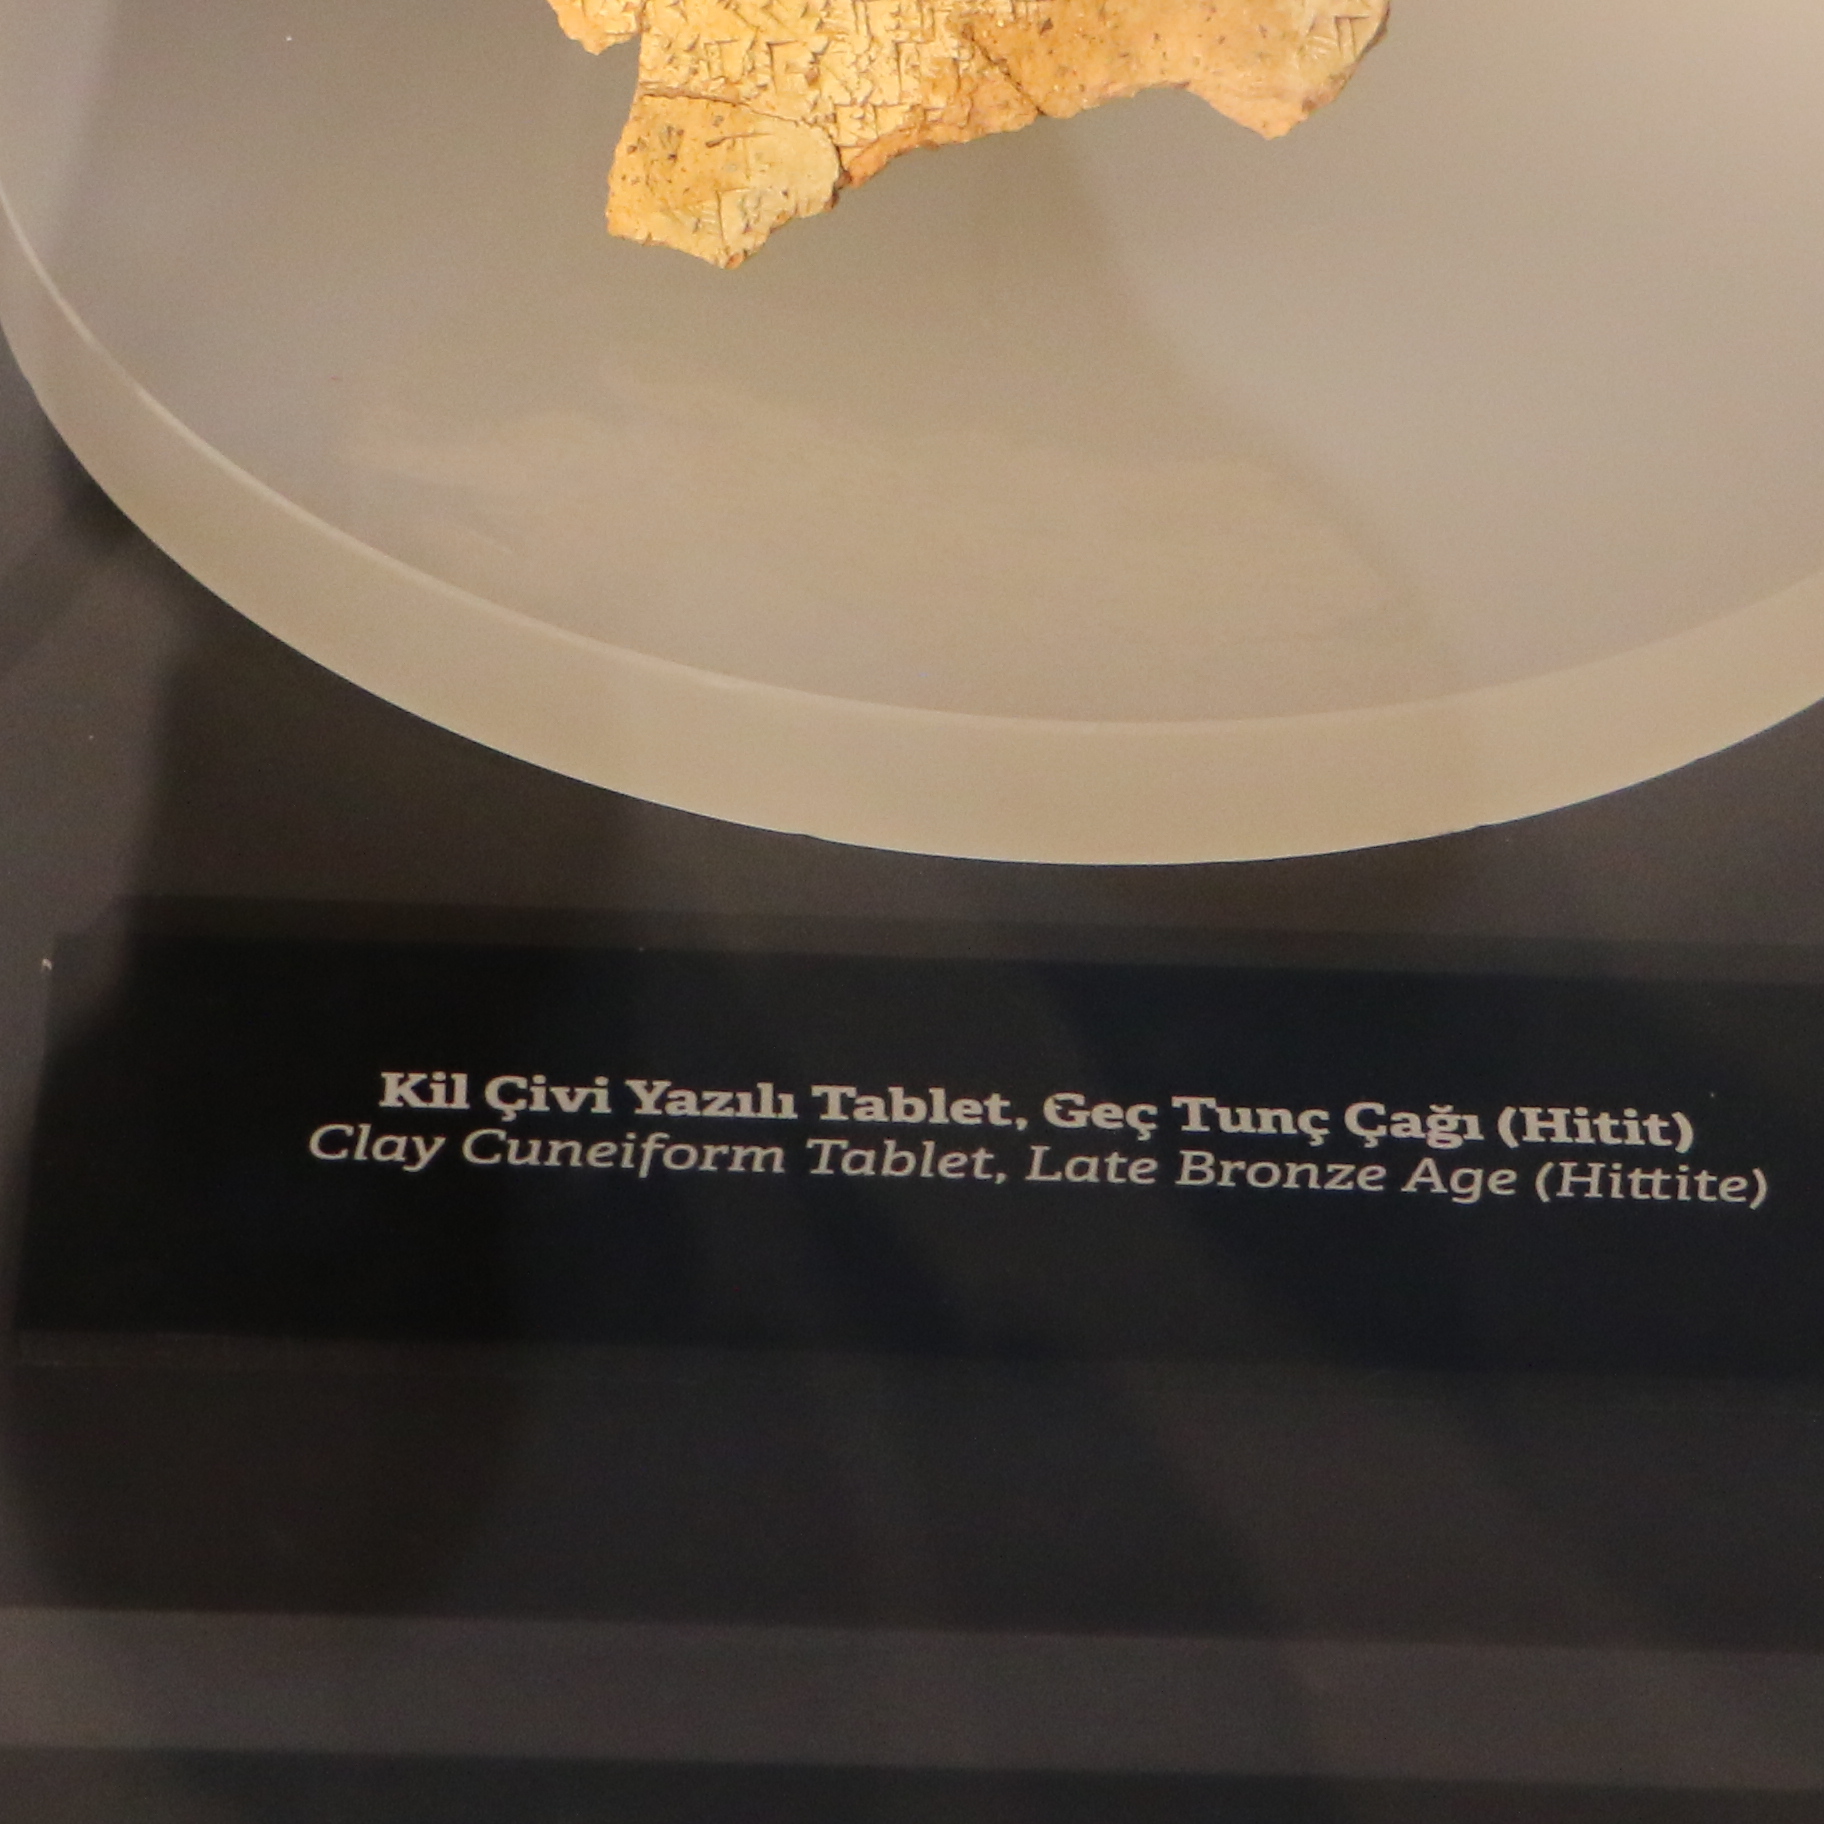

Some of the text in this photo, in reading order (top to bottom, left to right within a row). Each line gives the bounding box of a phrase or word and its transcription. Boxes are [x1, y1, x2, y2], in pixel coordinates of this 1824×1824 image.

[379, 1071, 1694, 1154] Kil Çivi Yazılı Tablet, Geç Tunç Çağı (Hitit)
[310, 1123, 1767, 1210] Clay Cuneiform Tablet, Late Bronze Age (Hittite)
